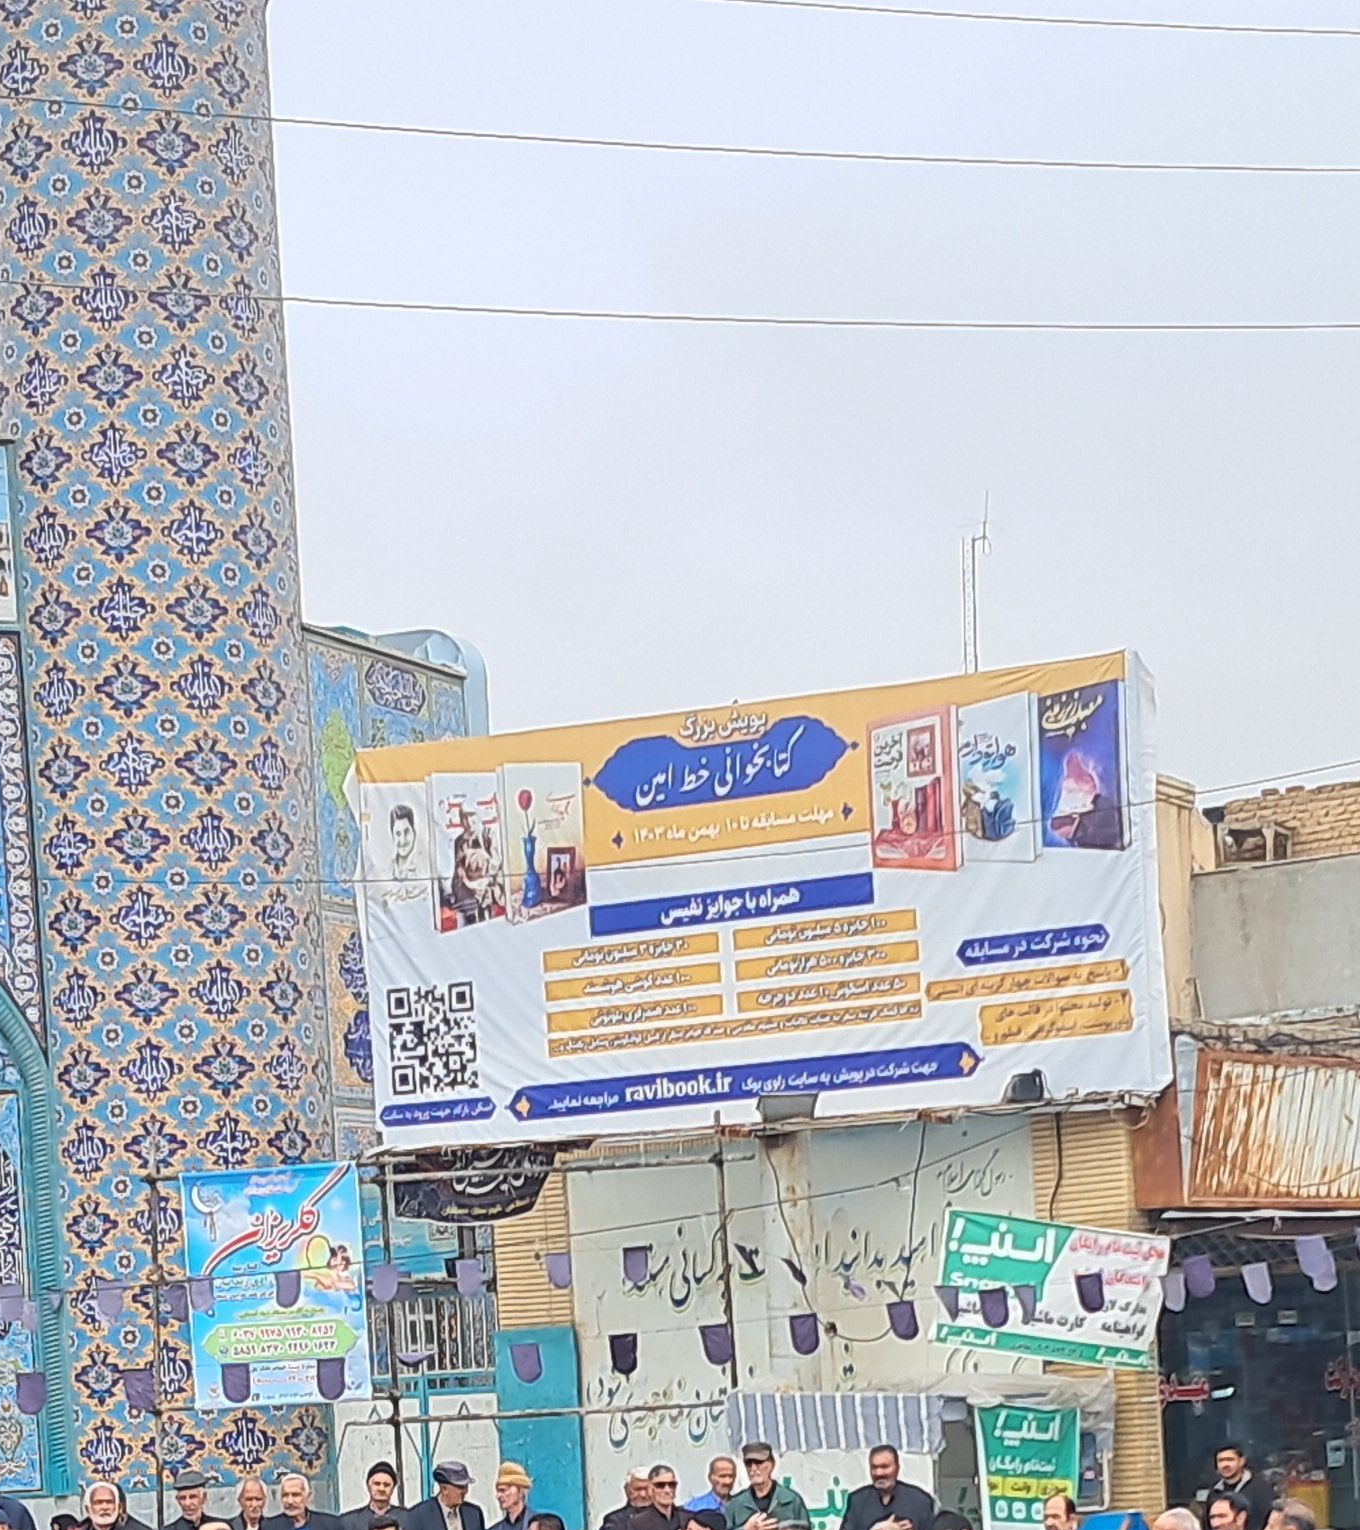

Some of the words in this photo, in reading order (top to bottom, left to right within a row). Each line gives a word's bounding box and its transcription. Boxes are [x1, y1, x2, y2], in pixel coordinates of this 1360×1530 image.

[679, 712, 718, 742] بزرگ
[718, 708, 768, 739] پویش
[713, 724, 806, 798] کتابخوانی
[635, 762, 674, 807] امین
[678, 755, 712, 793] خط
[725, 815, 738, 833] ۱۰
[738, 812, 751, 830] تا
[751, 811, 797, 830] مسابقه
[797, 804, 835, 823] مهلت
[665, 825, 687, 842] ماه
[688, 821, 721, 843] بهمن
[705, 892, 745, 921] جوایز
[743, 889, 757, 914] با
[757, 886, 802, 914] همراه
[659, 900, 704, 927] نفیس
[1011, 937, 1028, 959] در
[1029, 930, 1072, 955] شرکت
[1073, 928, 1107, 947] نحوه
[963, 940, 1011, 962] مسابقه
[818, 1072, 831, 1085] به
[831, 1067, 865, 1087] پویش
[875, 1061, 911, 1079] شرکت
[910, 1060, 939, 1077] جهت
[624, 1070, 734, 1104] ravibook.ir
[787, 1071, 819, 1090] سایت
[581, 1090, 620, 1110] مراجعه
[993, 1409, 1063, 1448] اسنپ!
[989, 1454, 1023, 1475] رایگان
[1010, 1481, 1033, 1495] وانت
